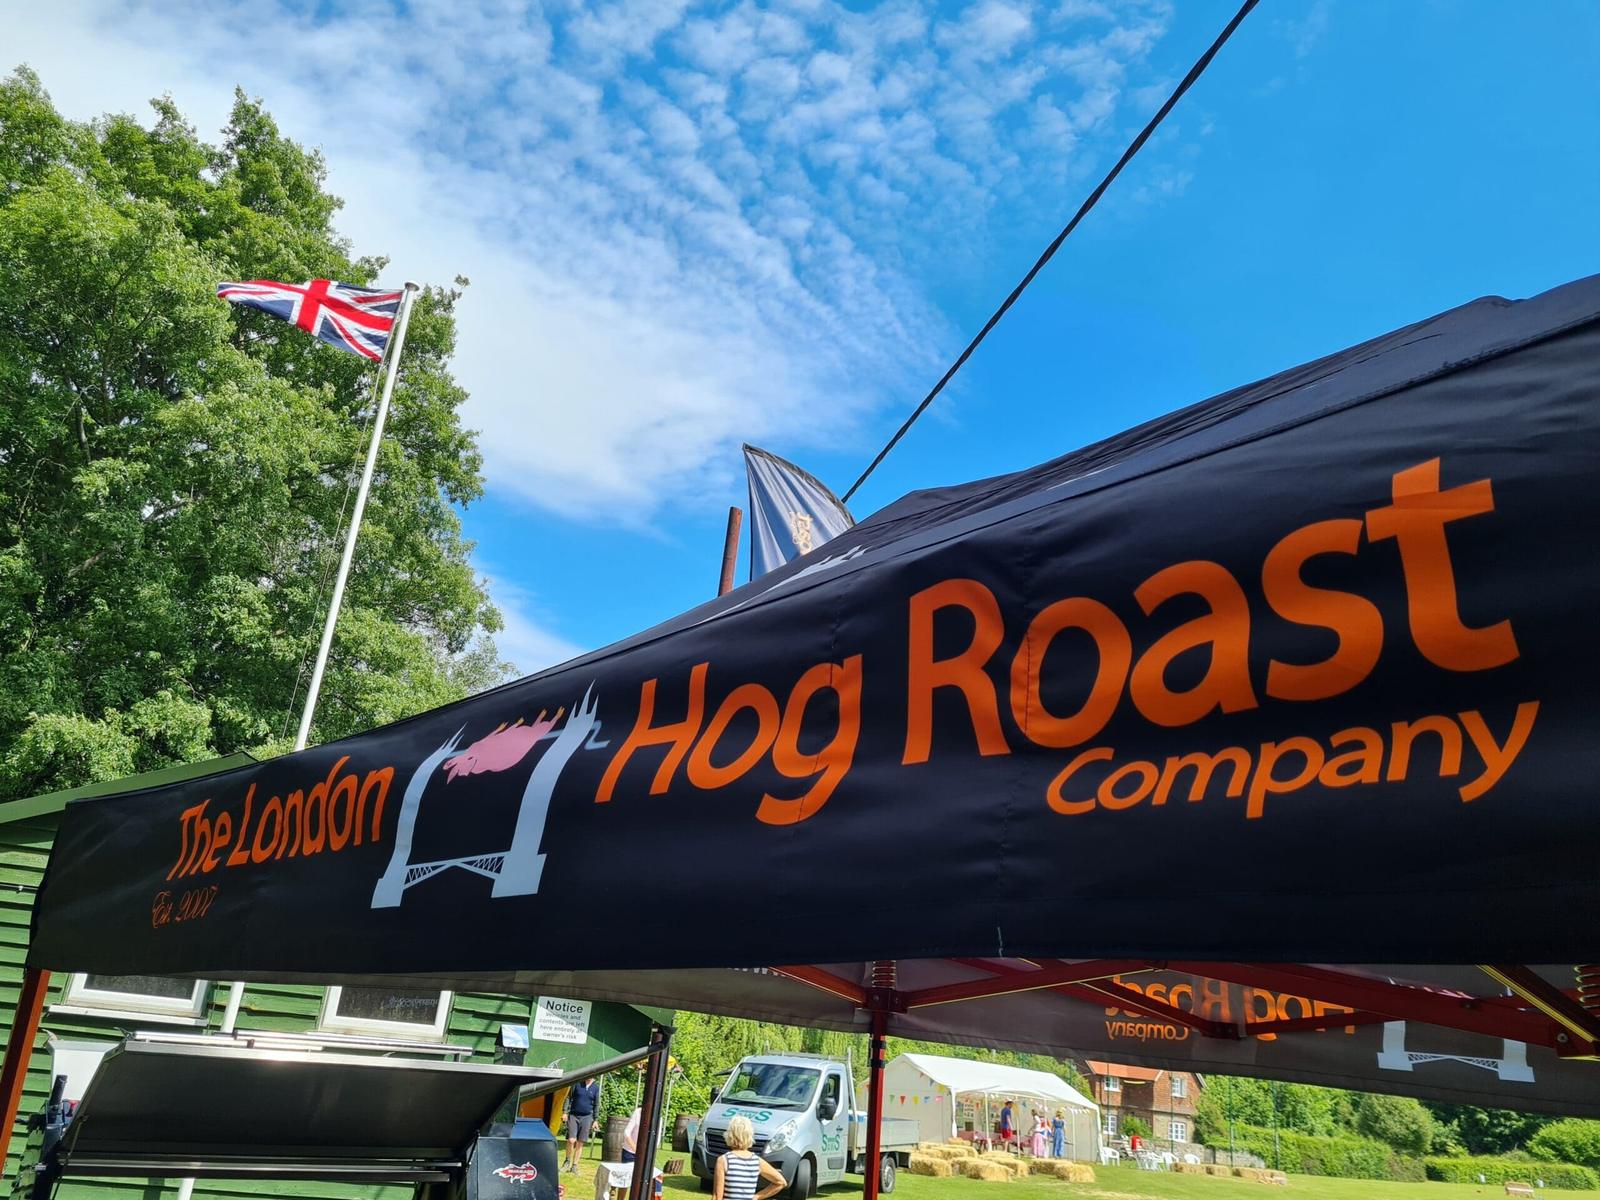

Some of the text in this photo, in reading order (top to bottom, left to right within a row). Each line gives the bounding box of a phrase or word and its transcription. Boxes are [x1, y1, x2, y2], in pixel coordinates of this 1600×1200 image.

[165, 456, 1521, 881] The London Hog Roast
[174, 884, 220, 922] 2007
[546, 1000, 583, 1014] Notice
